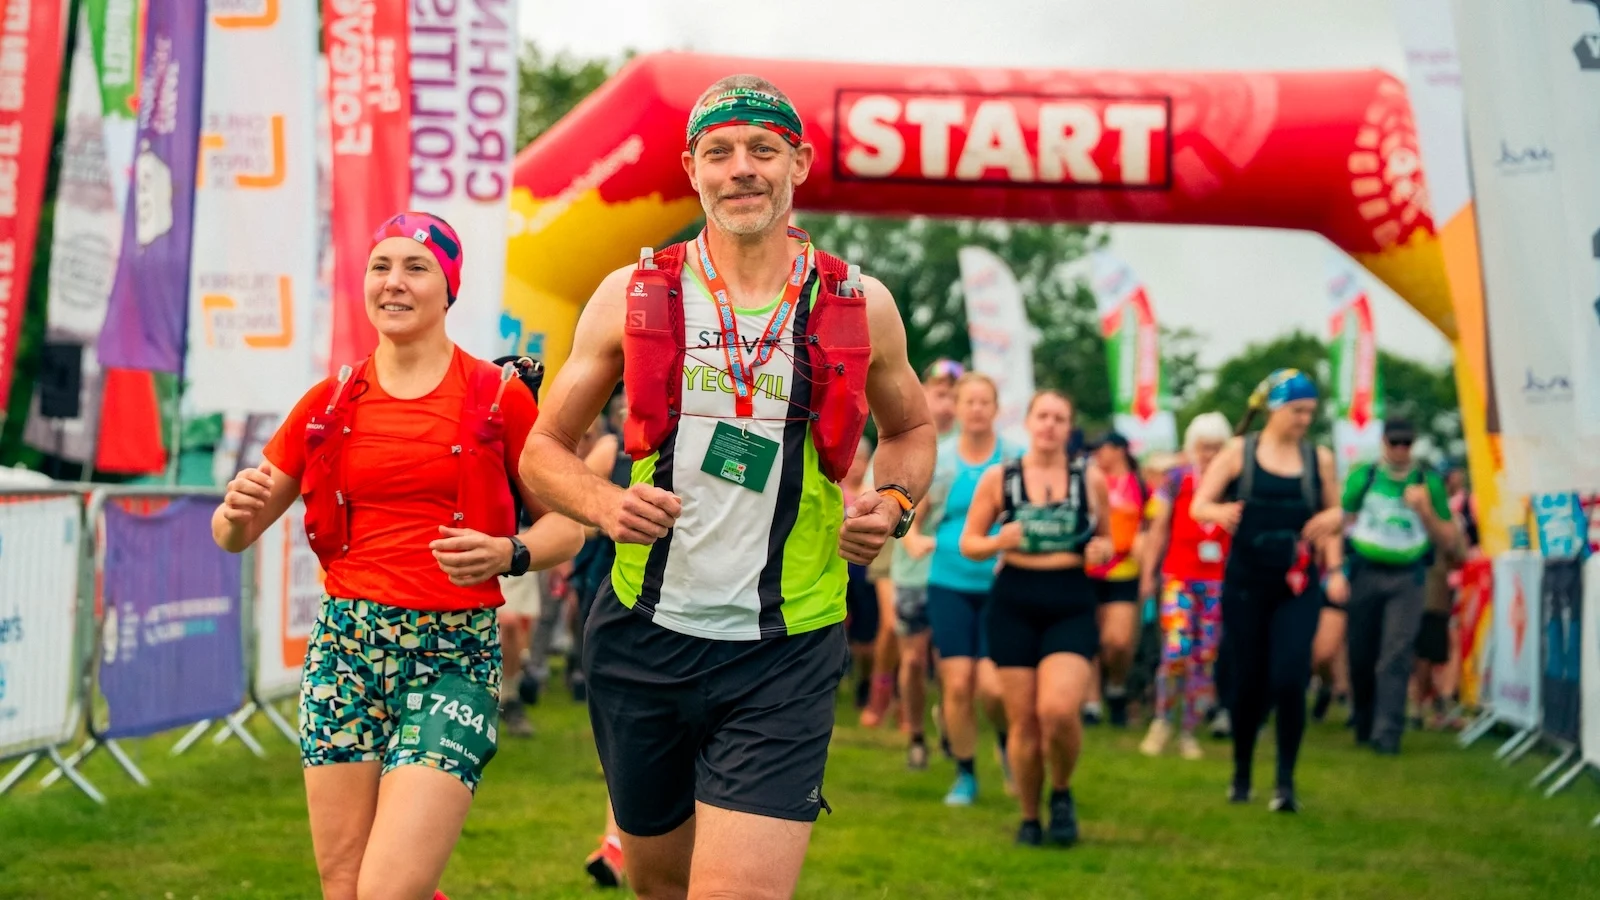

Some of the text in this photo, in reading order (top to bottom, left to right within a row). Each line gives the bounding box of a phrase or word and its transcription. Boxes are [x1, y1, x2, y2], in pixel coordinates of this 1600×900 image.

[844, 95, 1167, 184] START
[721, 305, 733, 330] 2025
[429, 693, 485, 735] 7434
[439, 737, 464, 753] 25KM
